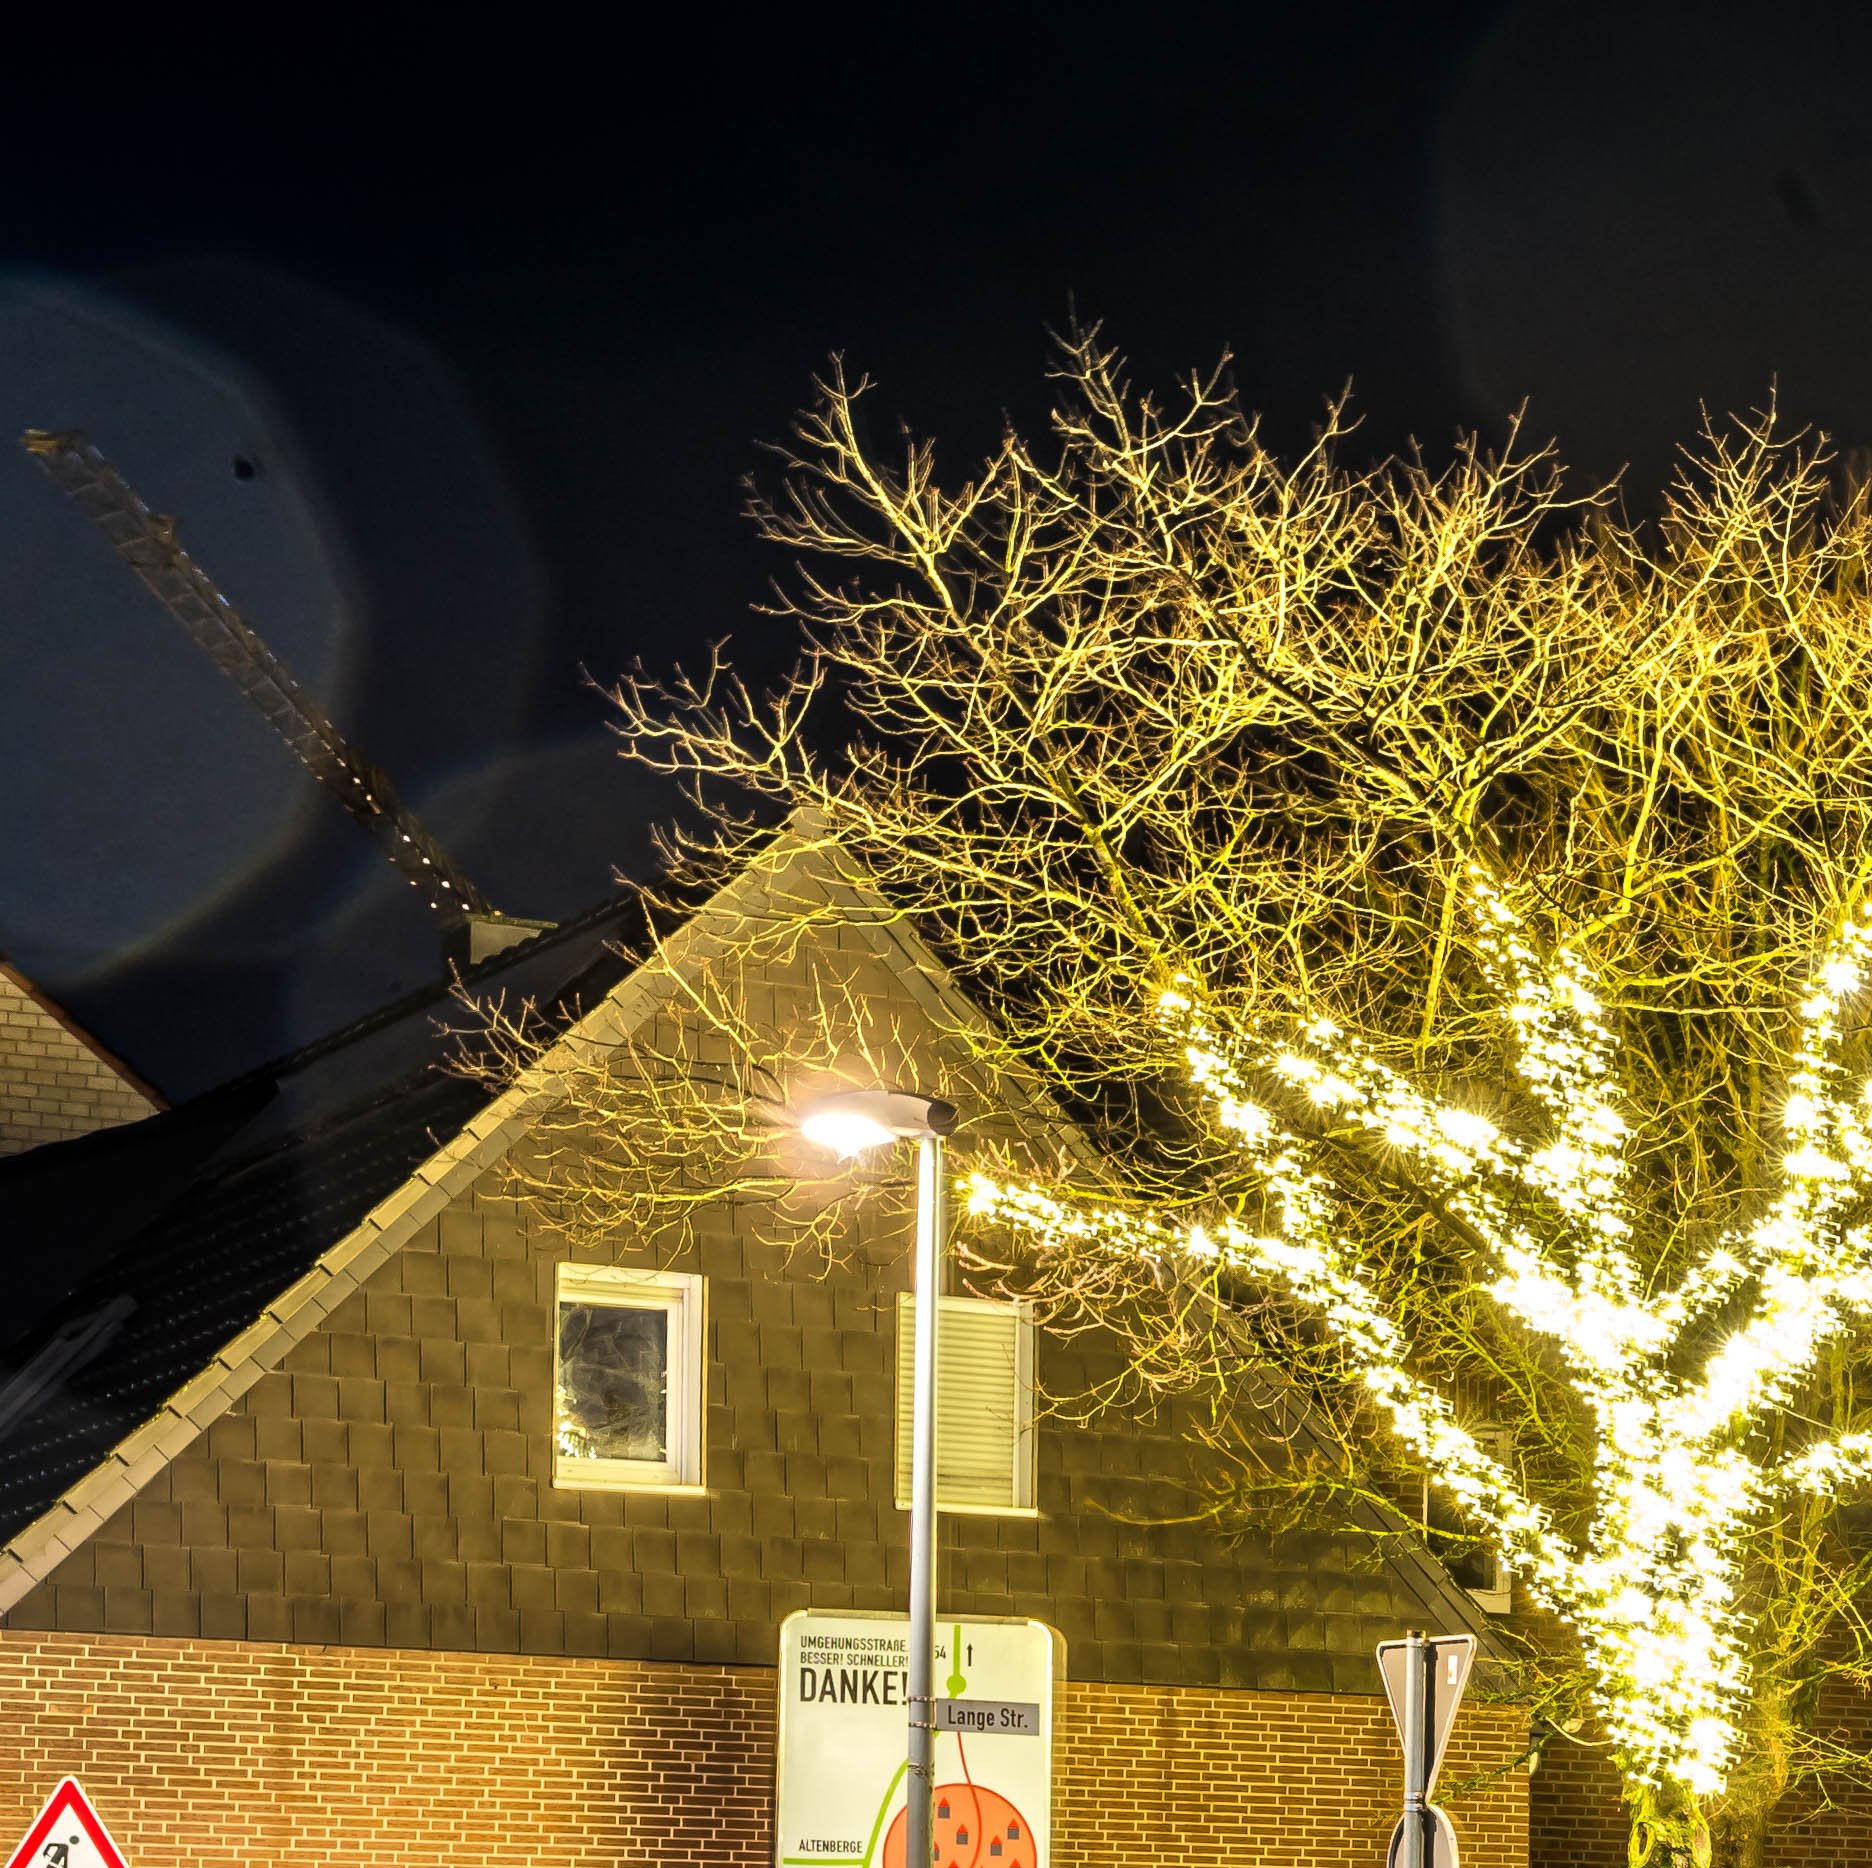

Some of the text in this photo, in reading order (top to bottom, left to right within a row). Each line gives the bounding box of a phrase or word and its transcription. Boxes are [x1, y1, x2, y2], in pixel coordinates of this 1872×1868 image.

[800, 1652, 909, 1668] BESSER! SCHNELLER!
[800, 1667, 908, 1706] DANKE!
[947, 1704, 1029, 1731] Lange Str.
[799, 1839, 863, 1853] ALTENBERGE
